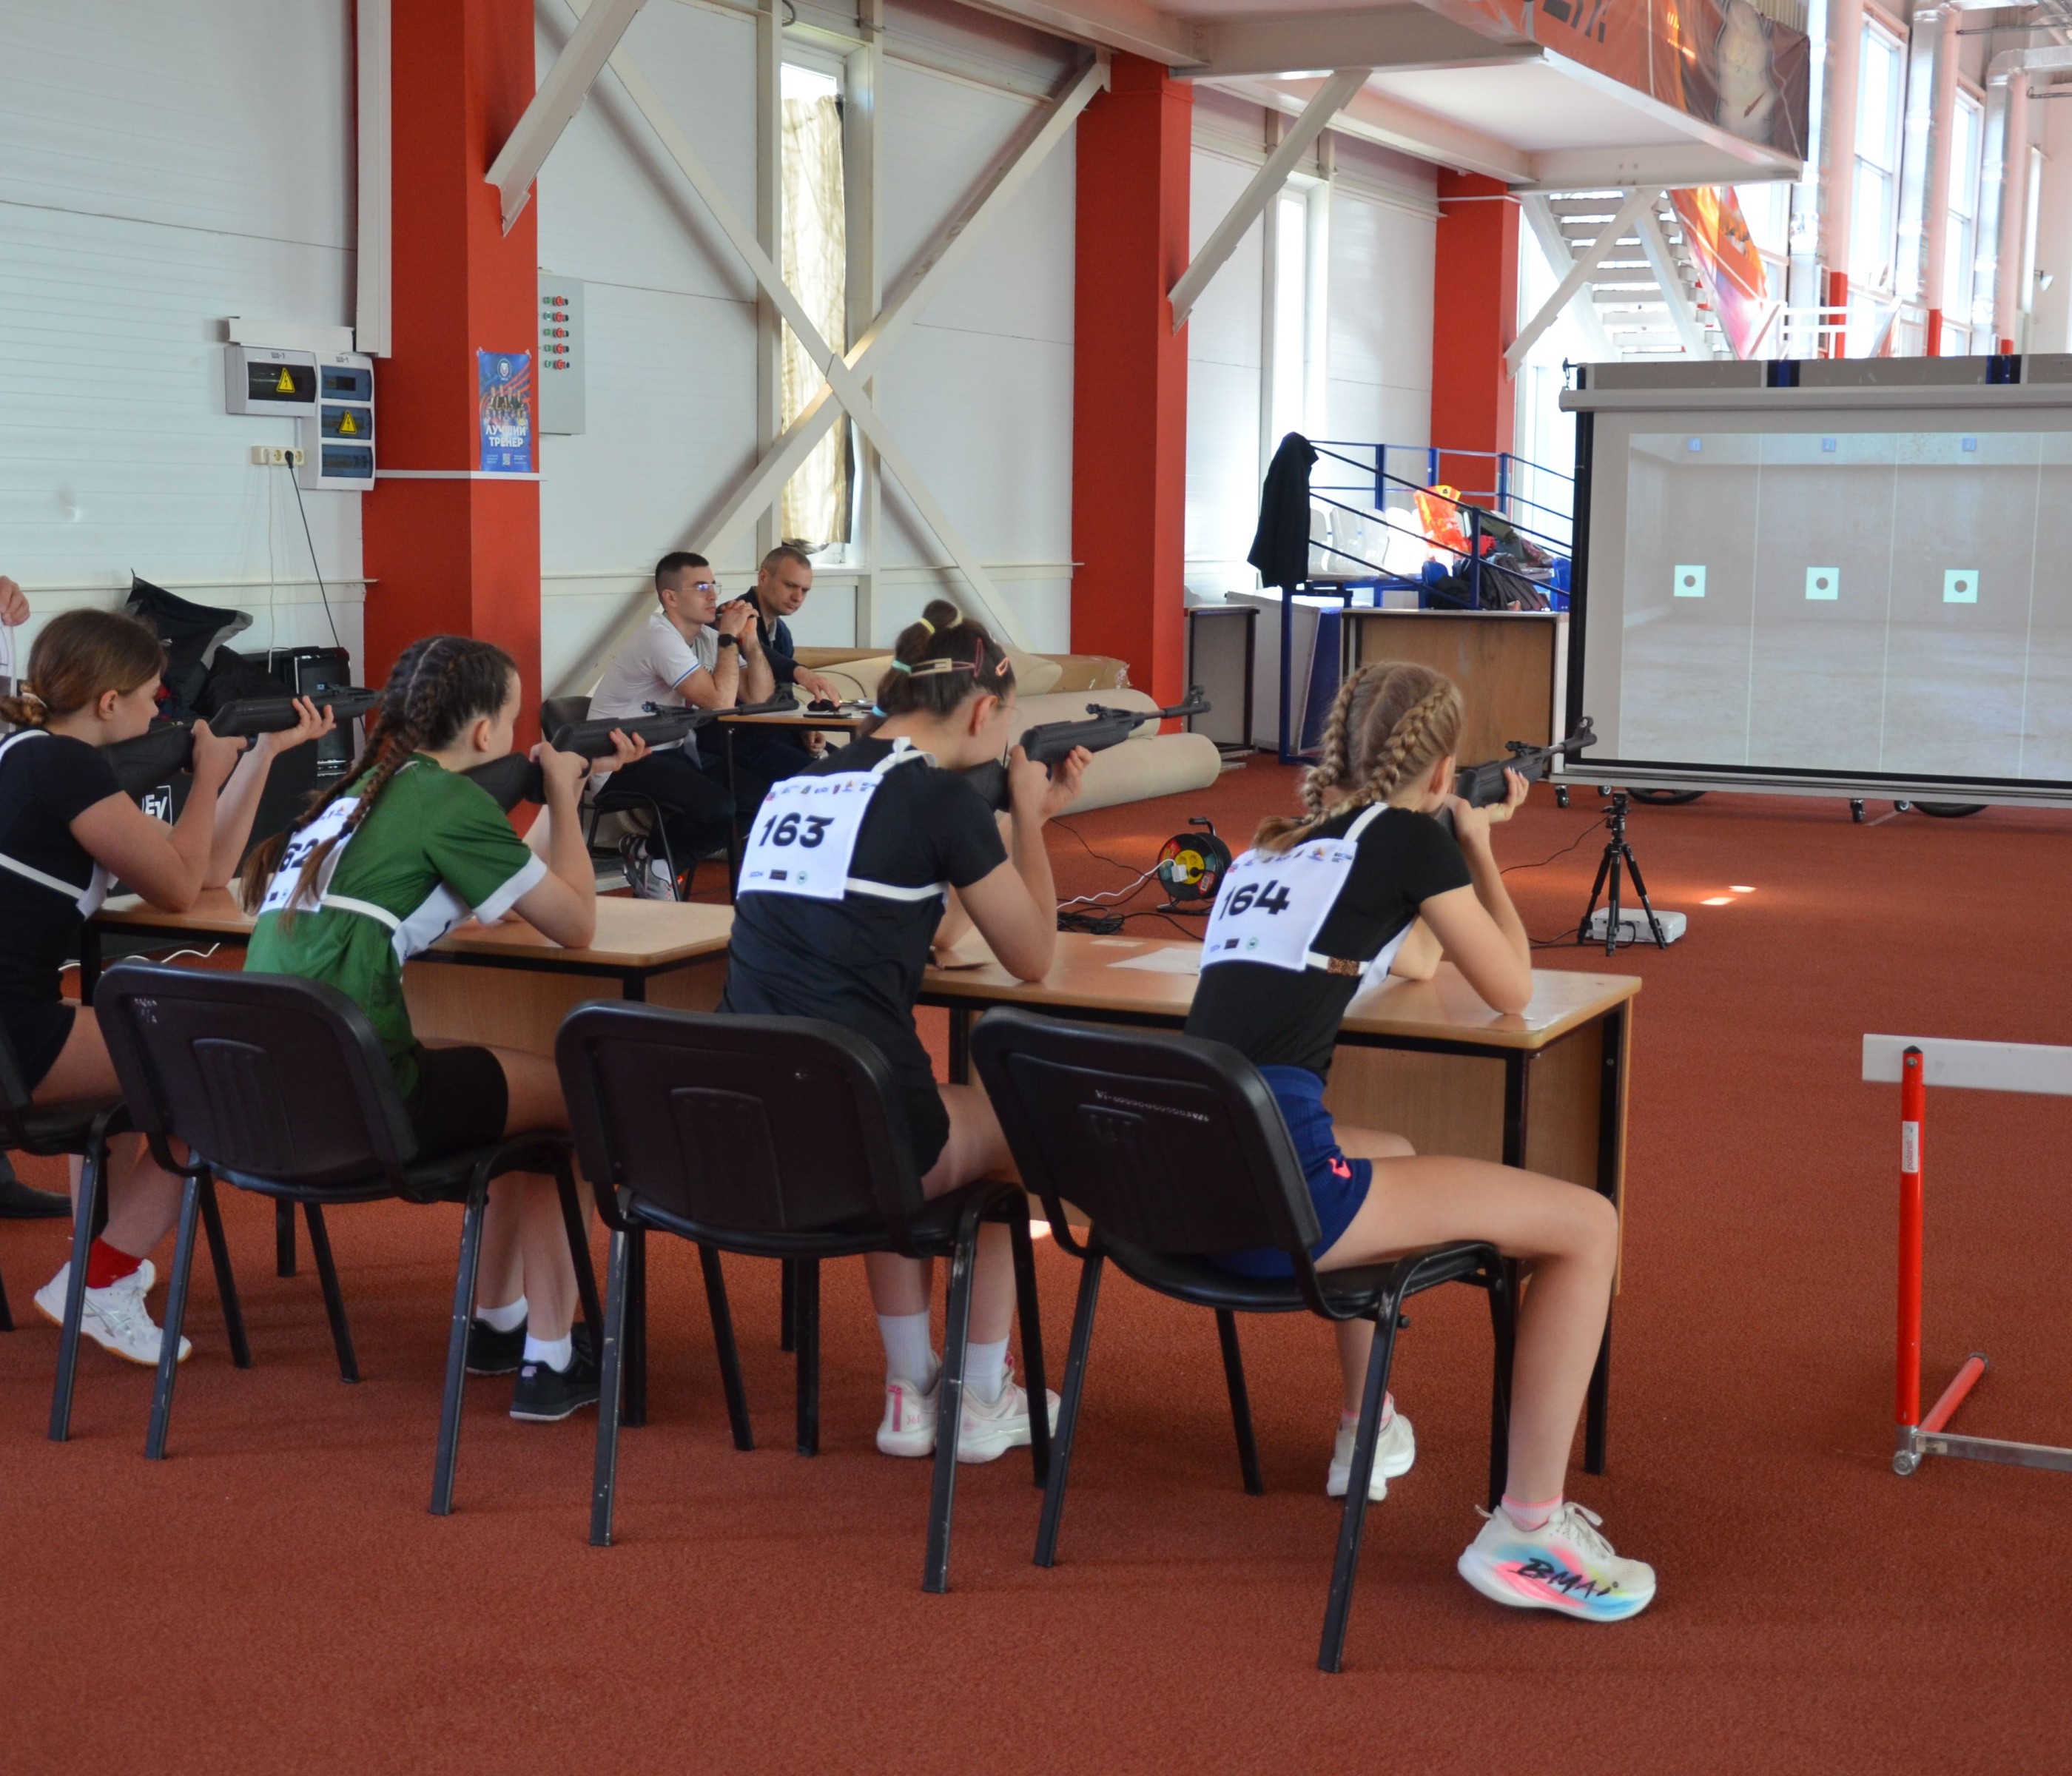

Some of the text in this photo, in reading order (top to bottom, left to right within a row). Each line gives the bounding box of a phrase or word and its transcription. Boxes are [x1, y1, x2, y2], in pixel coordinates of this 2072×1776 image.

[485, 424, 526, 437] ЛУЧШИЙ
[488, 436, 524, 448] ТРЕНЕР
[758, 811, 835, 849] 163
[279, 838, 319, 872] 62
[1219, 879, 1291, 921] 164
